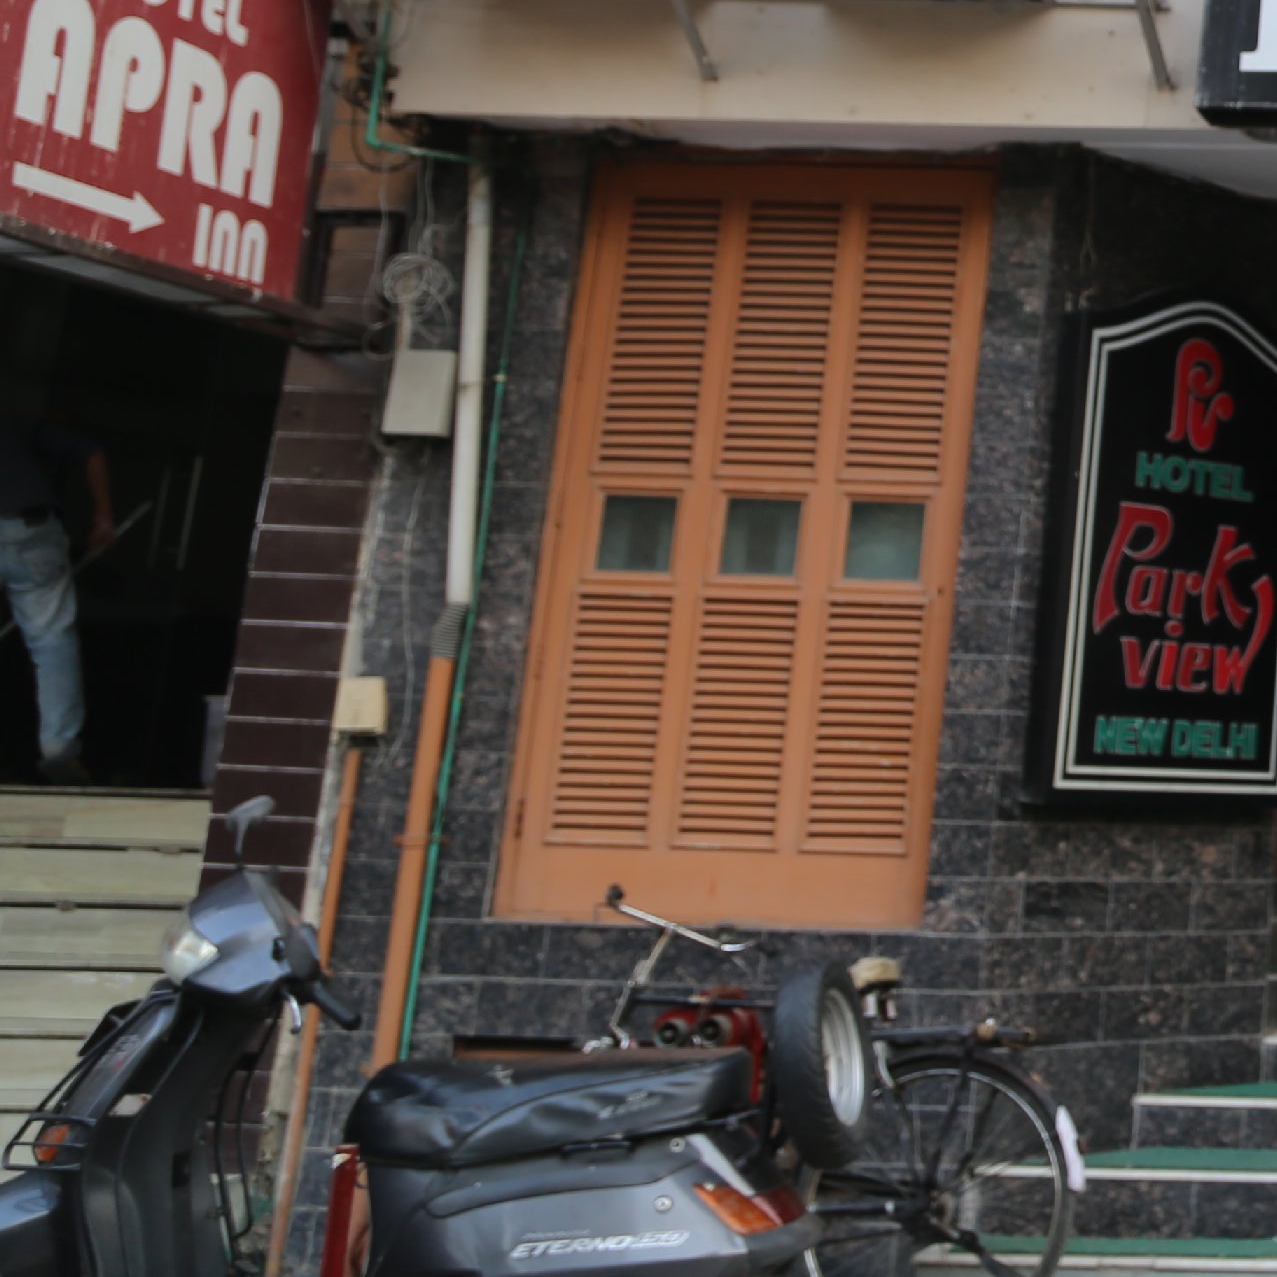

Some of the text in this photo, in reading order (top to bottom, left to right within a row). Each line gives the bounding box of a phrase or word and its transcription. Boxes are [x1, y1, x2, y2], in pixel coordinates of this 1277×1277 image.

[1134, 451, 1254, 502] HOTEL
[1093, 716, 1258, 760] NEW DELHI
